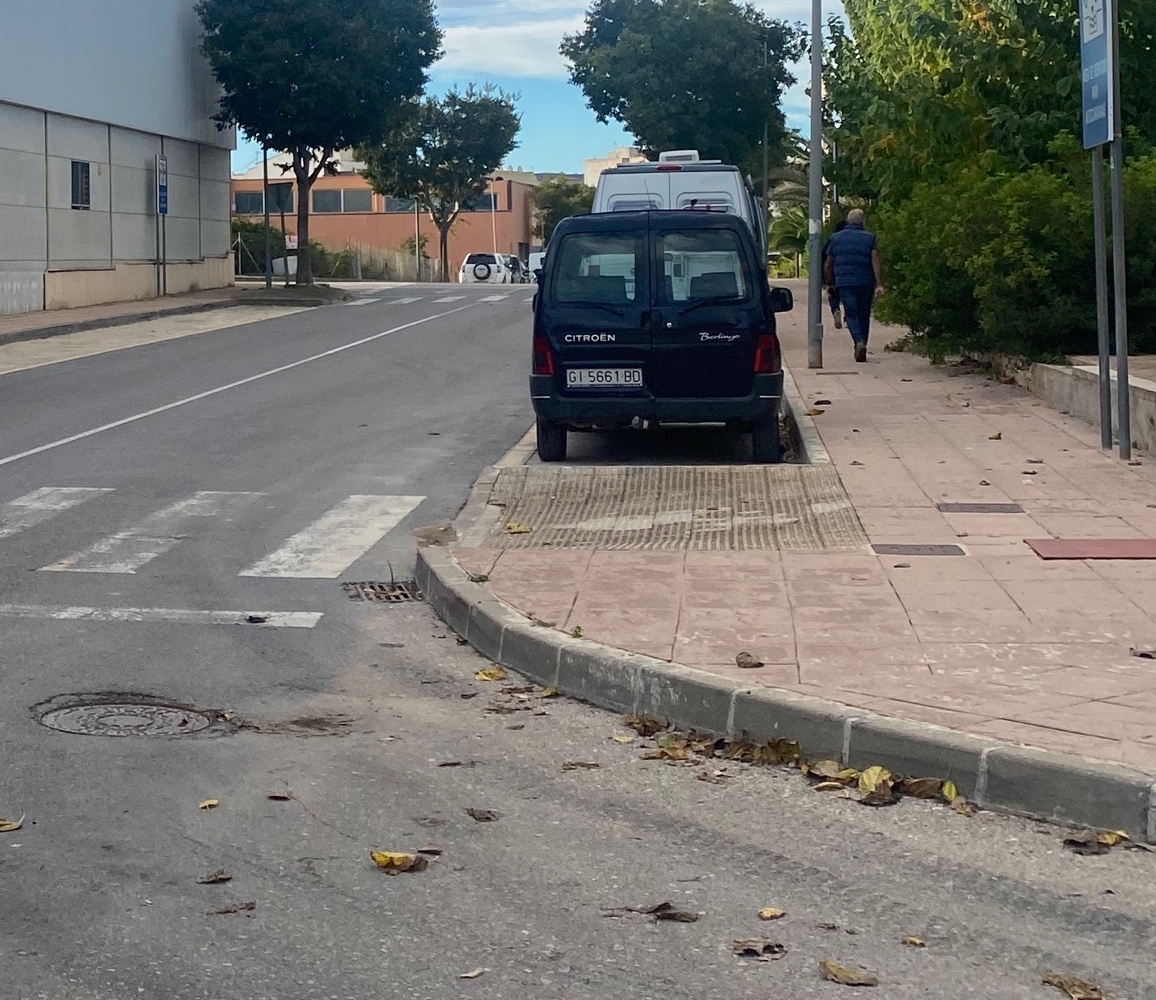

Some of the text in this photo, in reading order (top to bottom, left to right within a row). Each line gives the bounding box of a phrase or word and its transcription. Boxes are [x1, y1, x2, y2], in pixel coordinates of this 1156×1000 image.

[564, 332, 616, 342] CITROËN
[698, 332, 741, 342] Berlingo
[587, 370, 620, 383] 5661
[624, 370, 641, 383] BD
